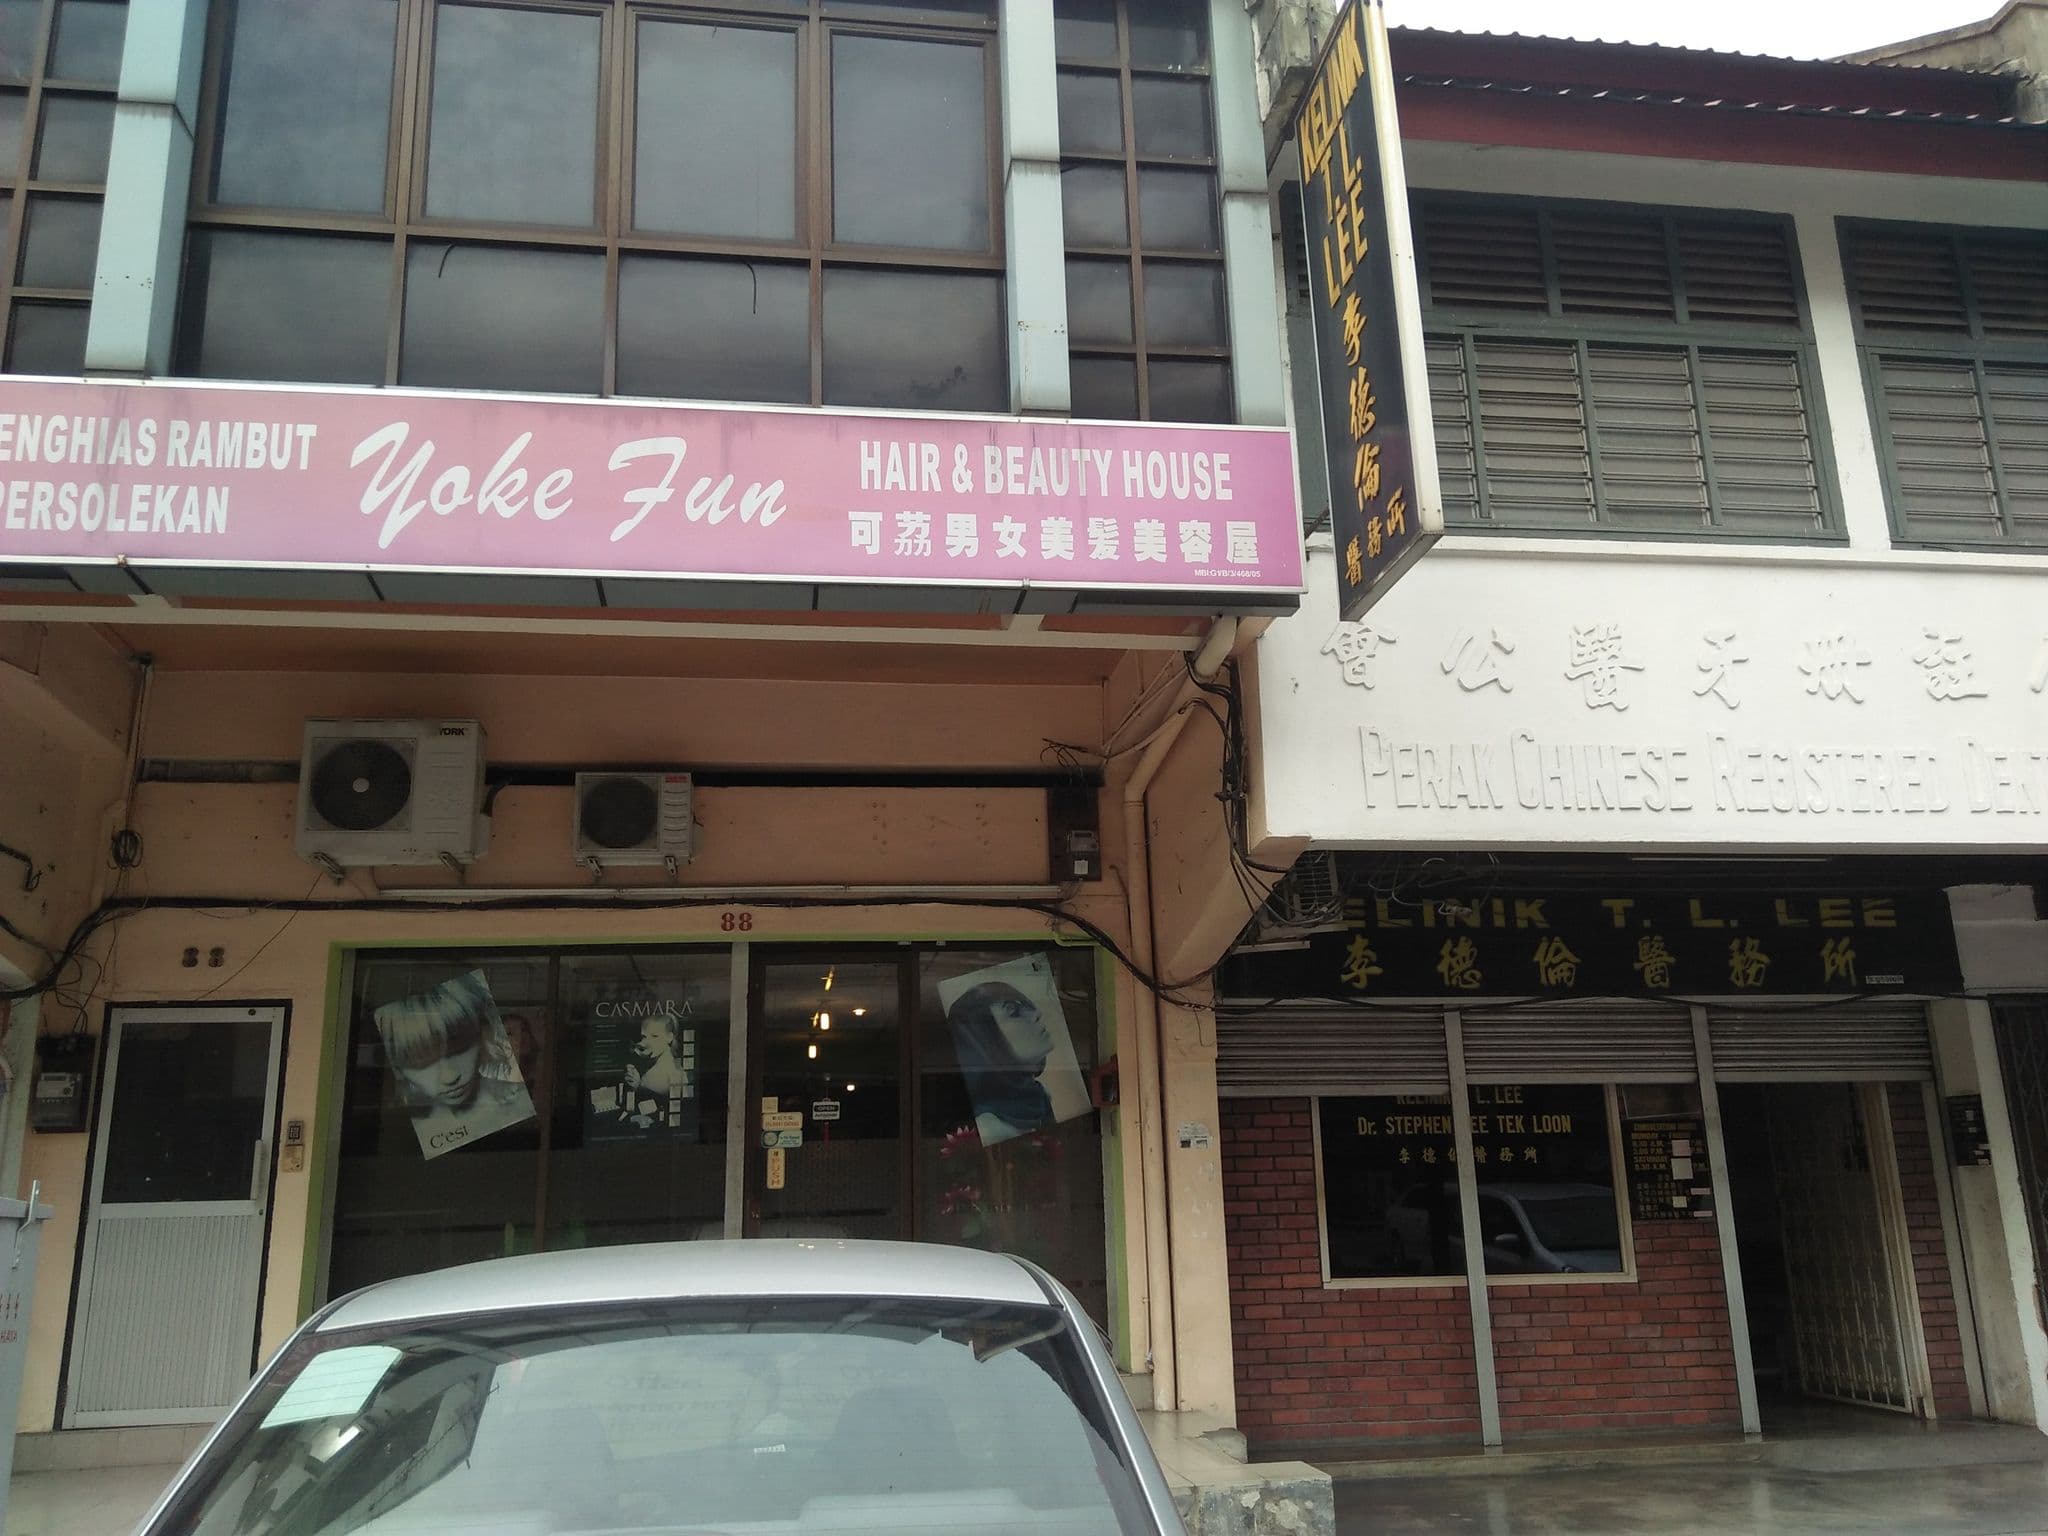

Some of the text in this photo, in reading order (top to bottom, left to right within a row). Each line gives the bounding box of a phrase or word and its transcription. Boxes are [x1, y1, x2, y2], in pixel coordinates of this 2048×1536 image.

[1299, 3, 1364, 186] KELINIK
[1323, 177, 1368, 309] LEE
[166, 419, 317, 471] RAMBUT
[859, 440, 1233, 501] HAIR & BEAUTY HOUSE
[0, 480, 229, 535] ERSOLEKAN
[349, 421, 788, 550] Yoke Fun
[1358, 726, 2048, 816] PERAK CHINESE REGISTERED DEN
[721, 912, 753, 932] 88
[1343, 897, 1898, 931] ELINIK T. L. LEE
[595, 999, 694, 1019] CASMARA
[1494, 1085, 1525, 1105] LEE
[1357, 1113, 1573, 1136] Dr. STEPHEN EE TEK LOON
